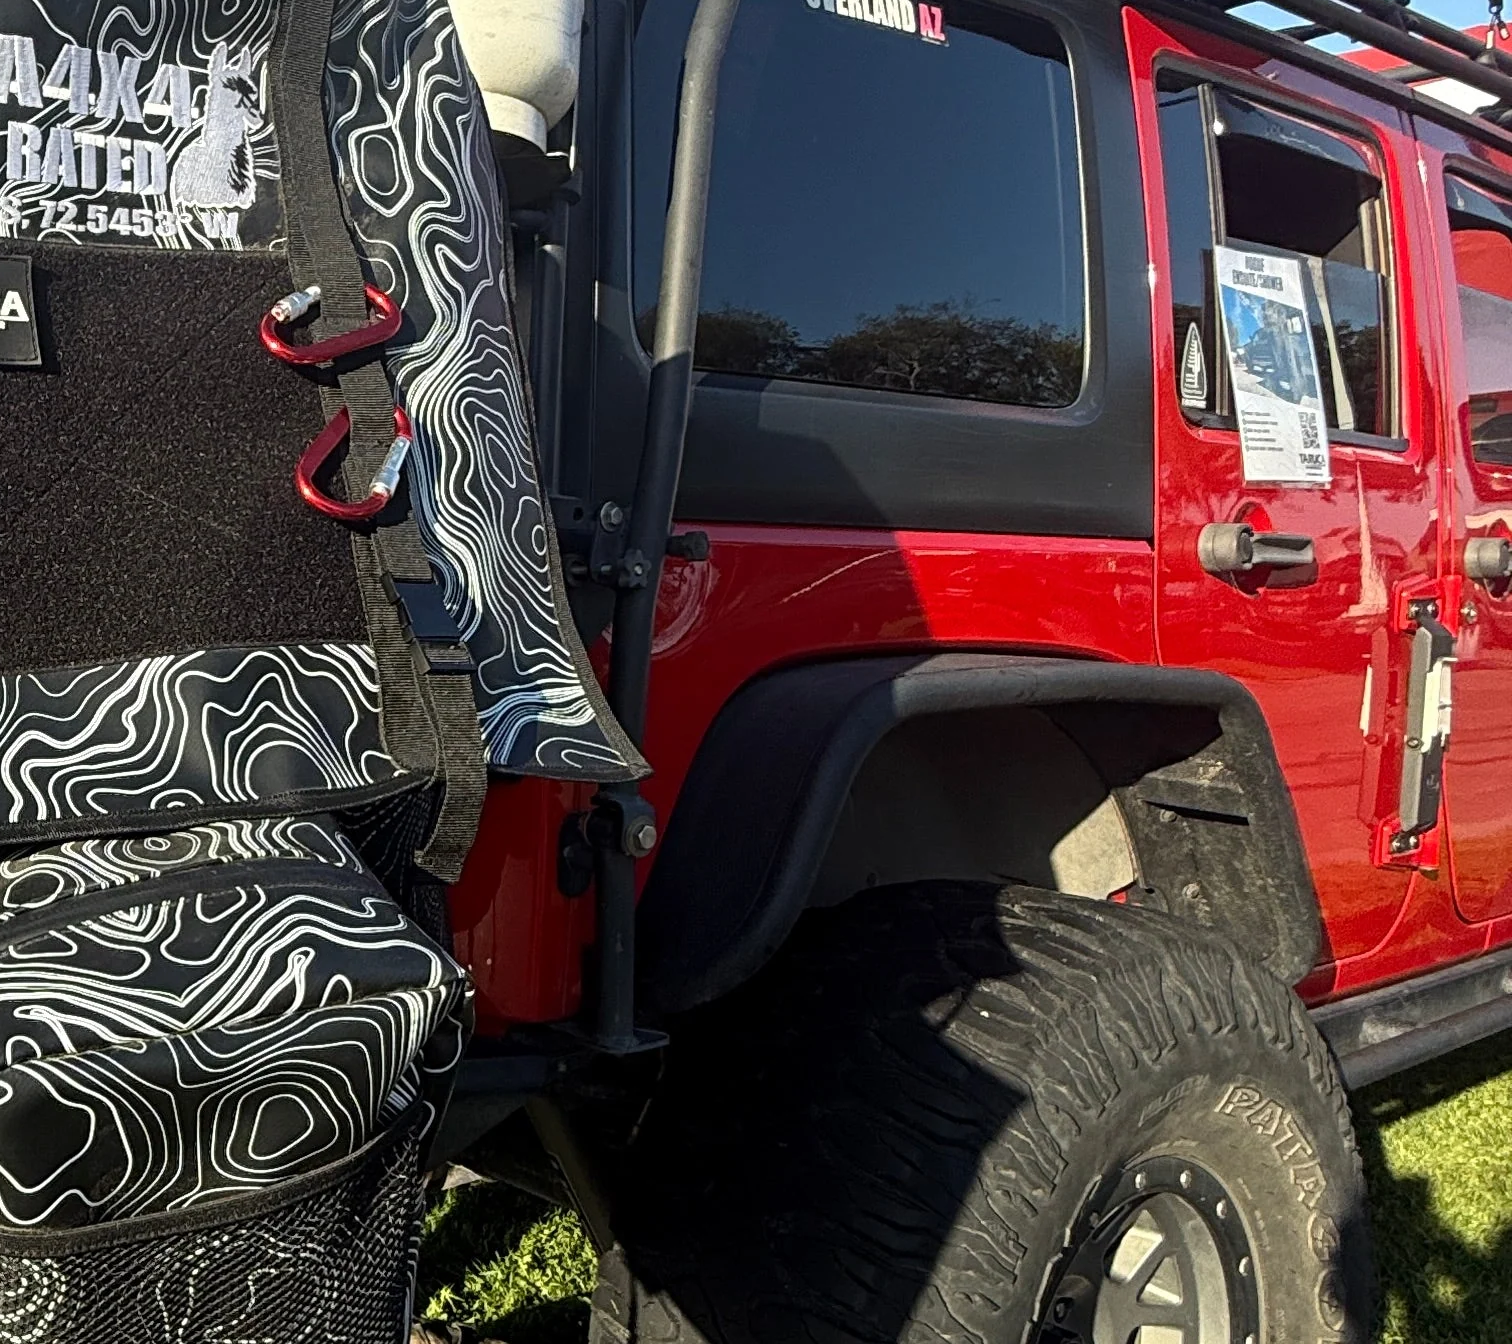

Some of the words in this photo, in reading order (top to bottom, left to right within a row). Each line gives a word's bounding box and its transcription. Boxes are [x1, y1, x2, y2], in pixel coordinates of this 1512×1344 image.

[918, 3, 946, 41] AZ
[6, 120, 168, 196] RATED
[201, 212, 239, 239] W
